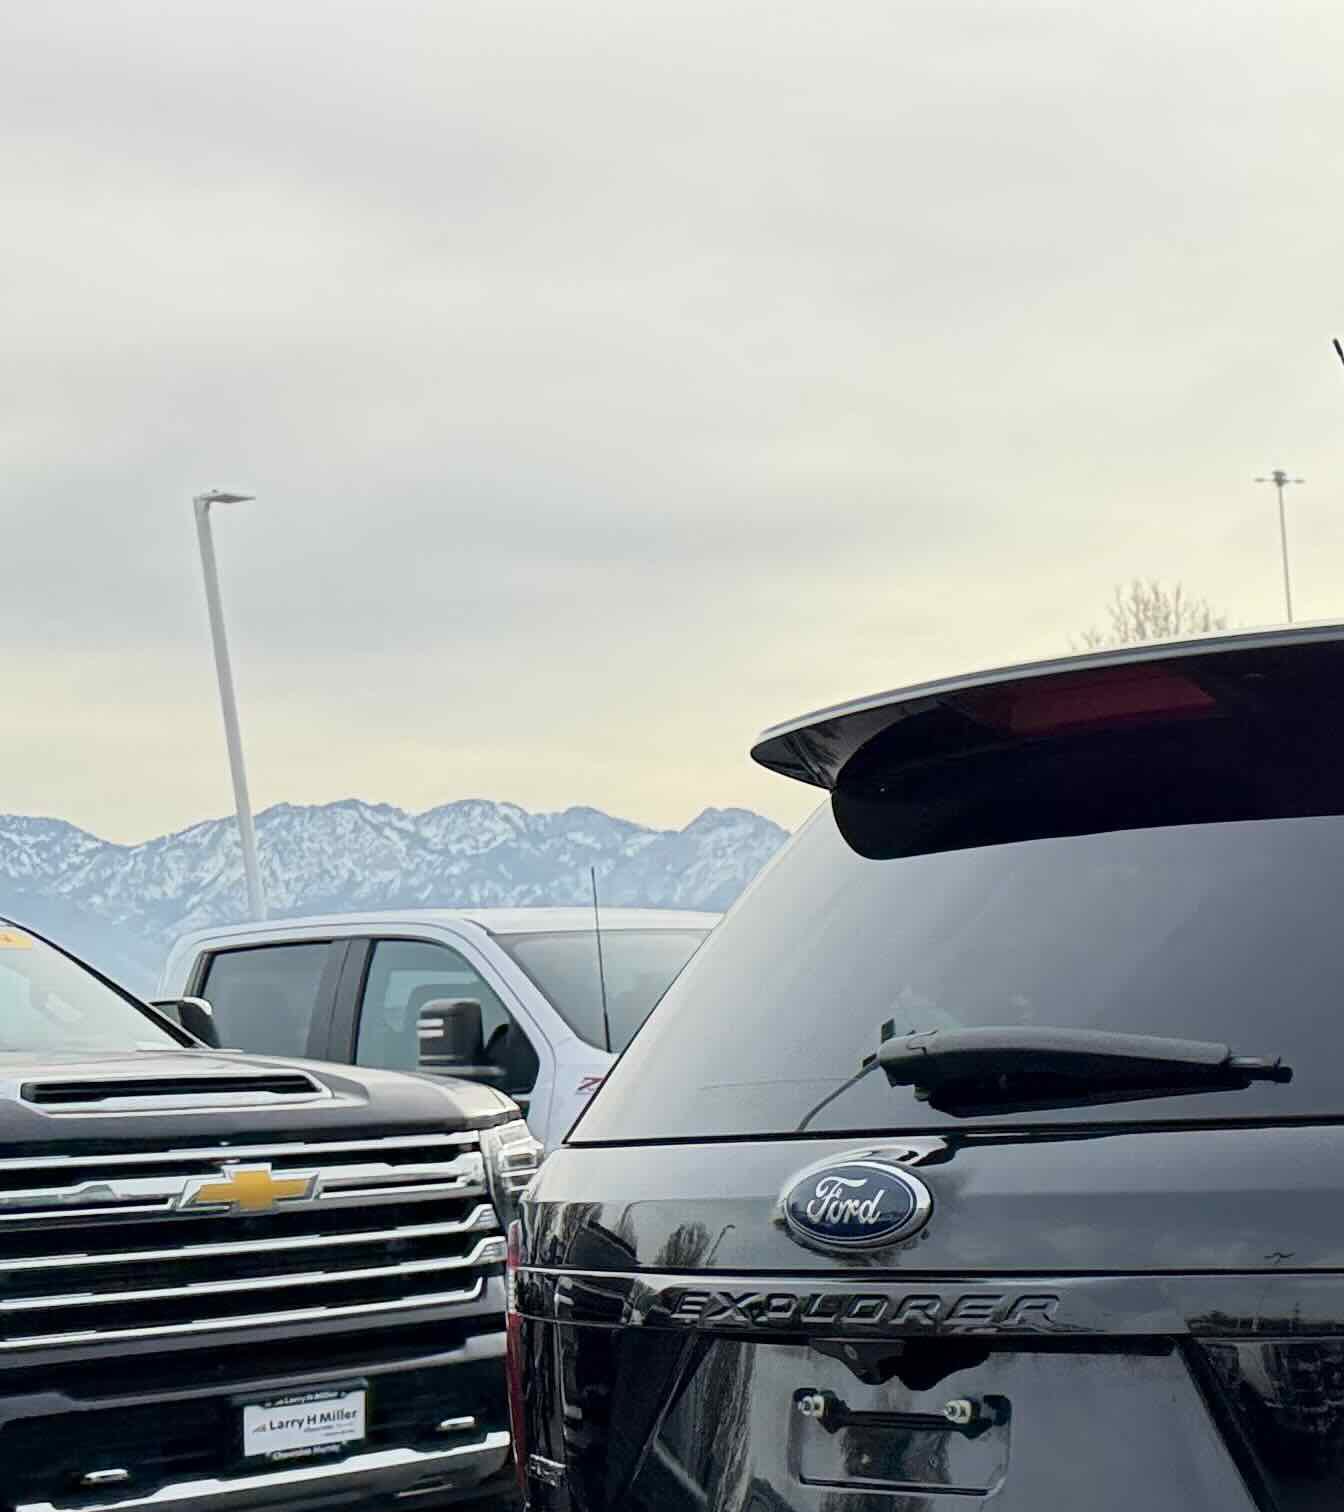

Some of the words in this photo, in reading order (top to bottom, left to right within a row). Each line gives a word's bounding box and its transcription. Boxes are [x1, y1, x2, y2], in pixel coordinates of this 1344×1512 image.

[806, 1176, 885, 1224] Ford
[670, 1291, 1060, 1326] EXPLORER
[269, 1418, 305, 1430] Larry
[307, 1414, 316, 1425] H
[319, 1408, 357, 1424] Miller
